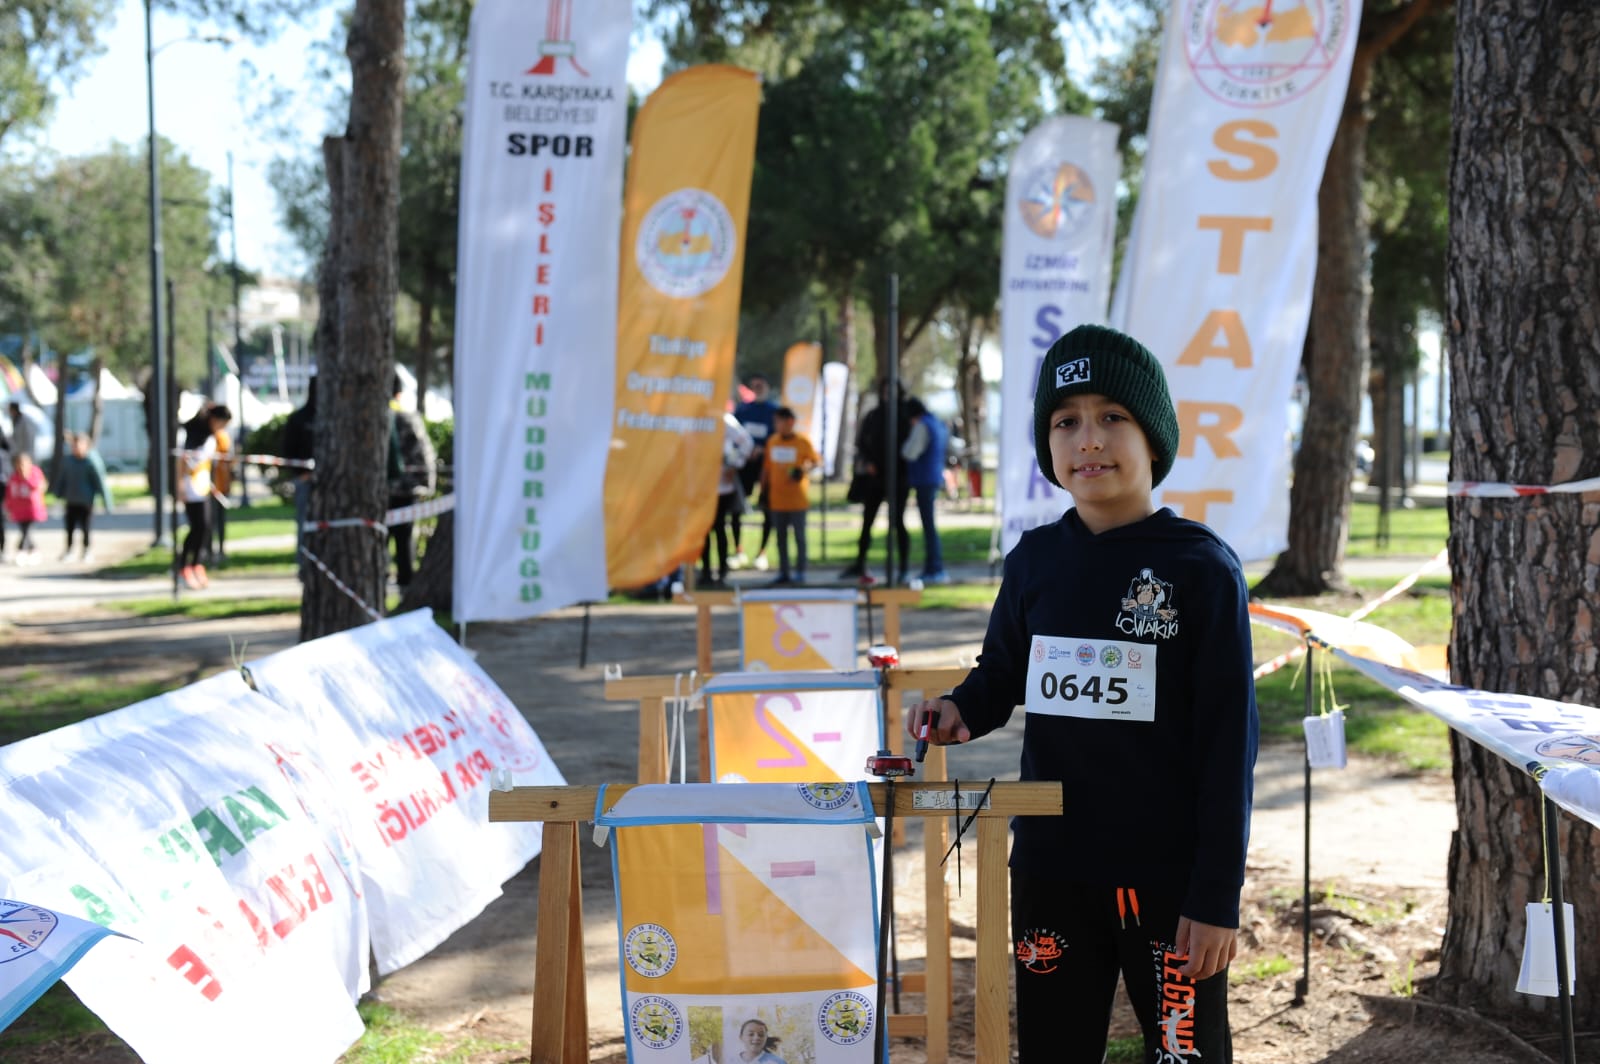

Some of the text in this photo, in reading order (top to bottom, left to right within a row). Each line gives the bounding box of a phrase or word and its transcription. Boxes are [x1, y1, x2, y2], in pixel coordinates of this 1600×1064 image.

[488, 81, 614, 103] T.C. KARŞIYAKA
[507, 132, 595, 158] SPOR
[1160, 118, 1280, 523] START
[1040, 671, 1129, 705] 0645
